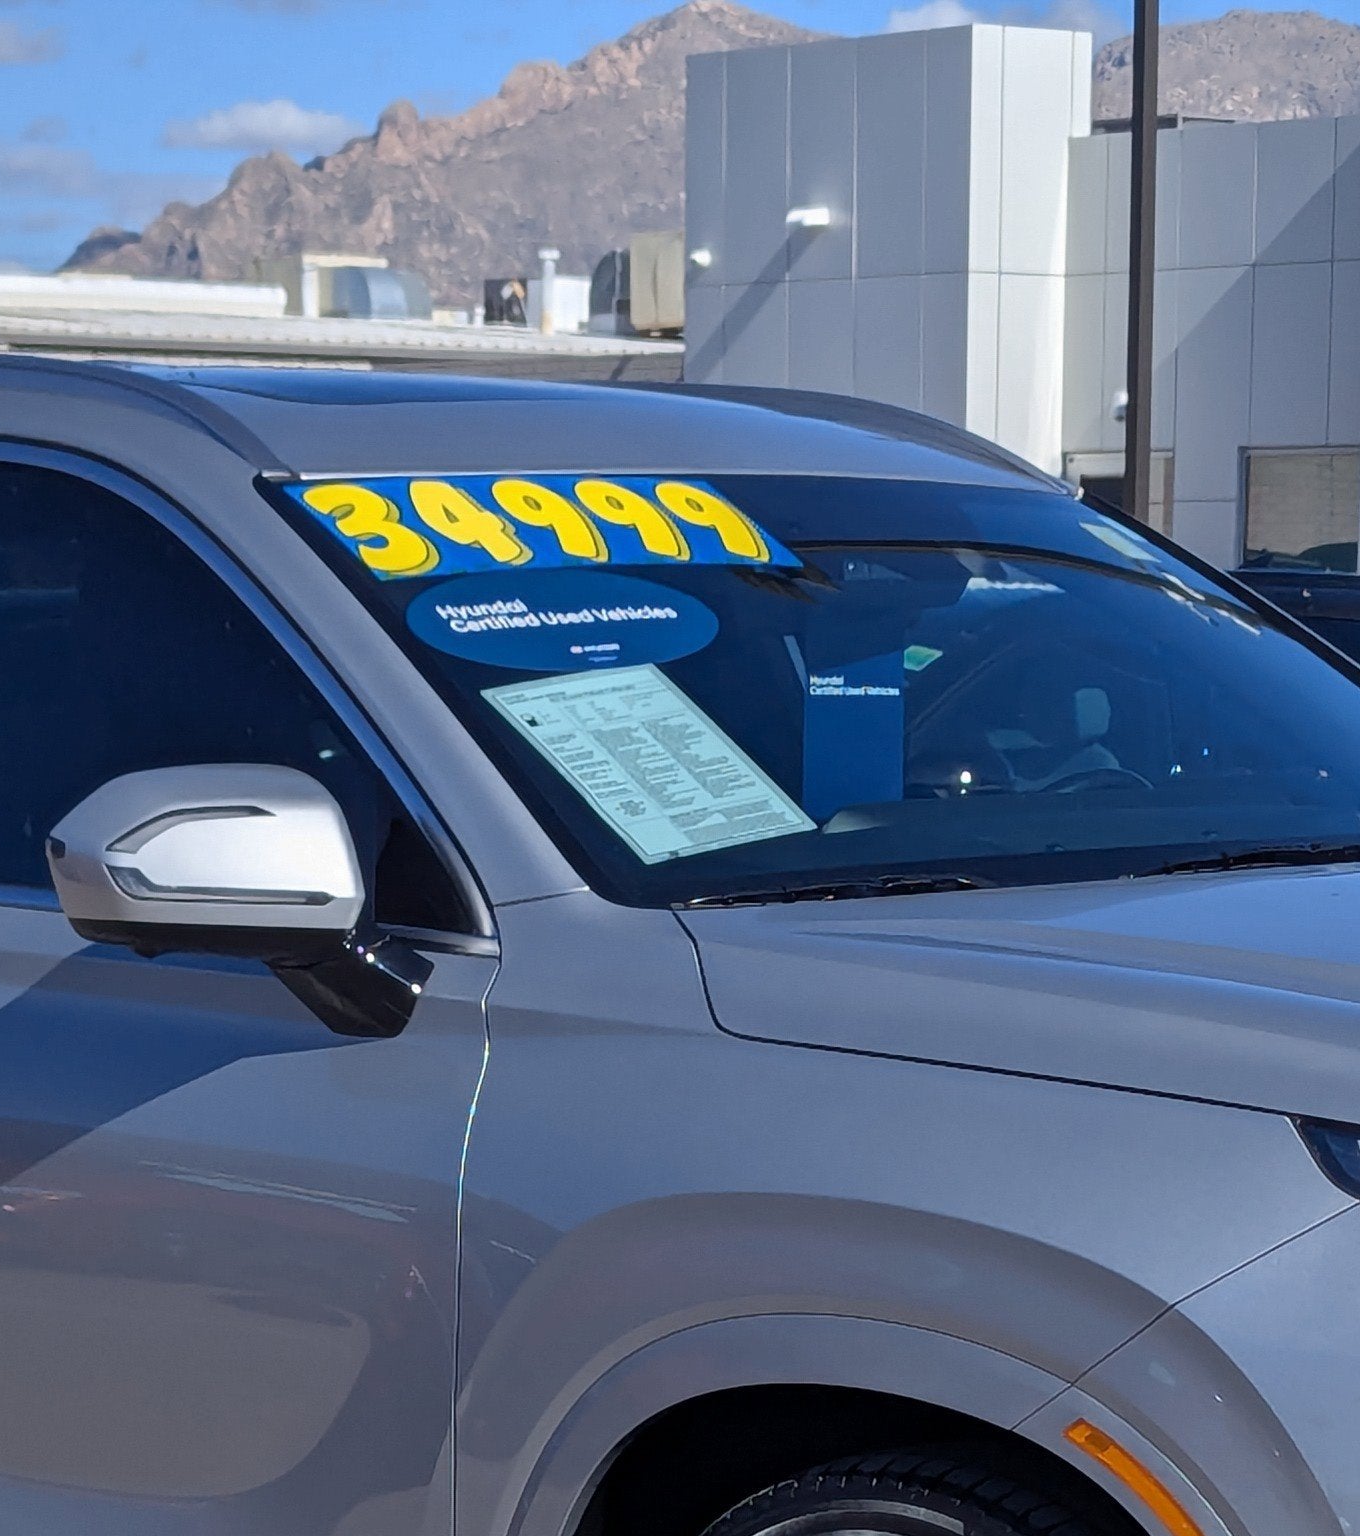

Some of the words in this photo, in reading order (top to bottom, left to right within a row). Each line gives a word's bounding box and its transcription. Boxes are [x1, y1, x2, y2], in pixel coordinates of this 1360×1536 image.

[302, 478, 771, 574] 34999
[435, 599, 528, 620] Hyundai
[449, 611, 541, 633] Certified
[541, 607, 595, 625] Used
[591, 604, 678, 622] Vehicles
